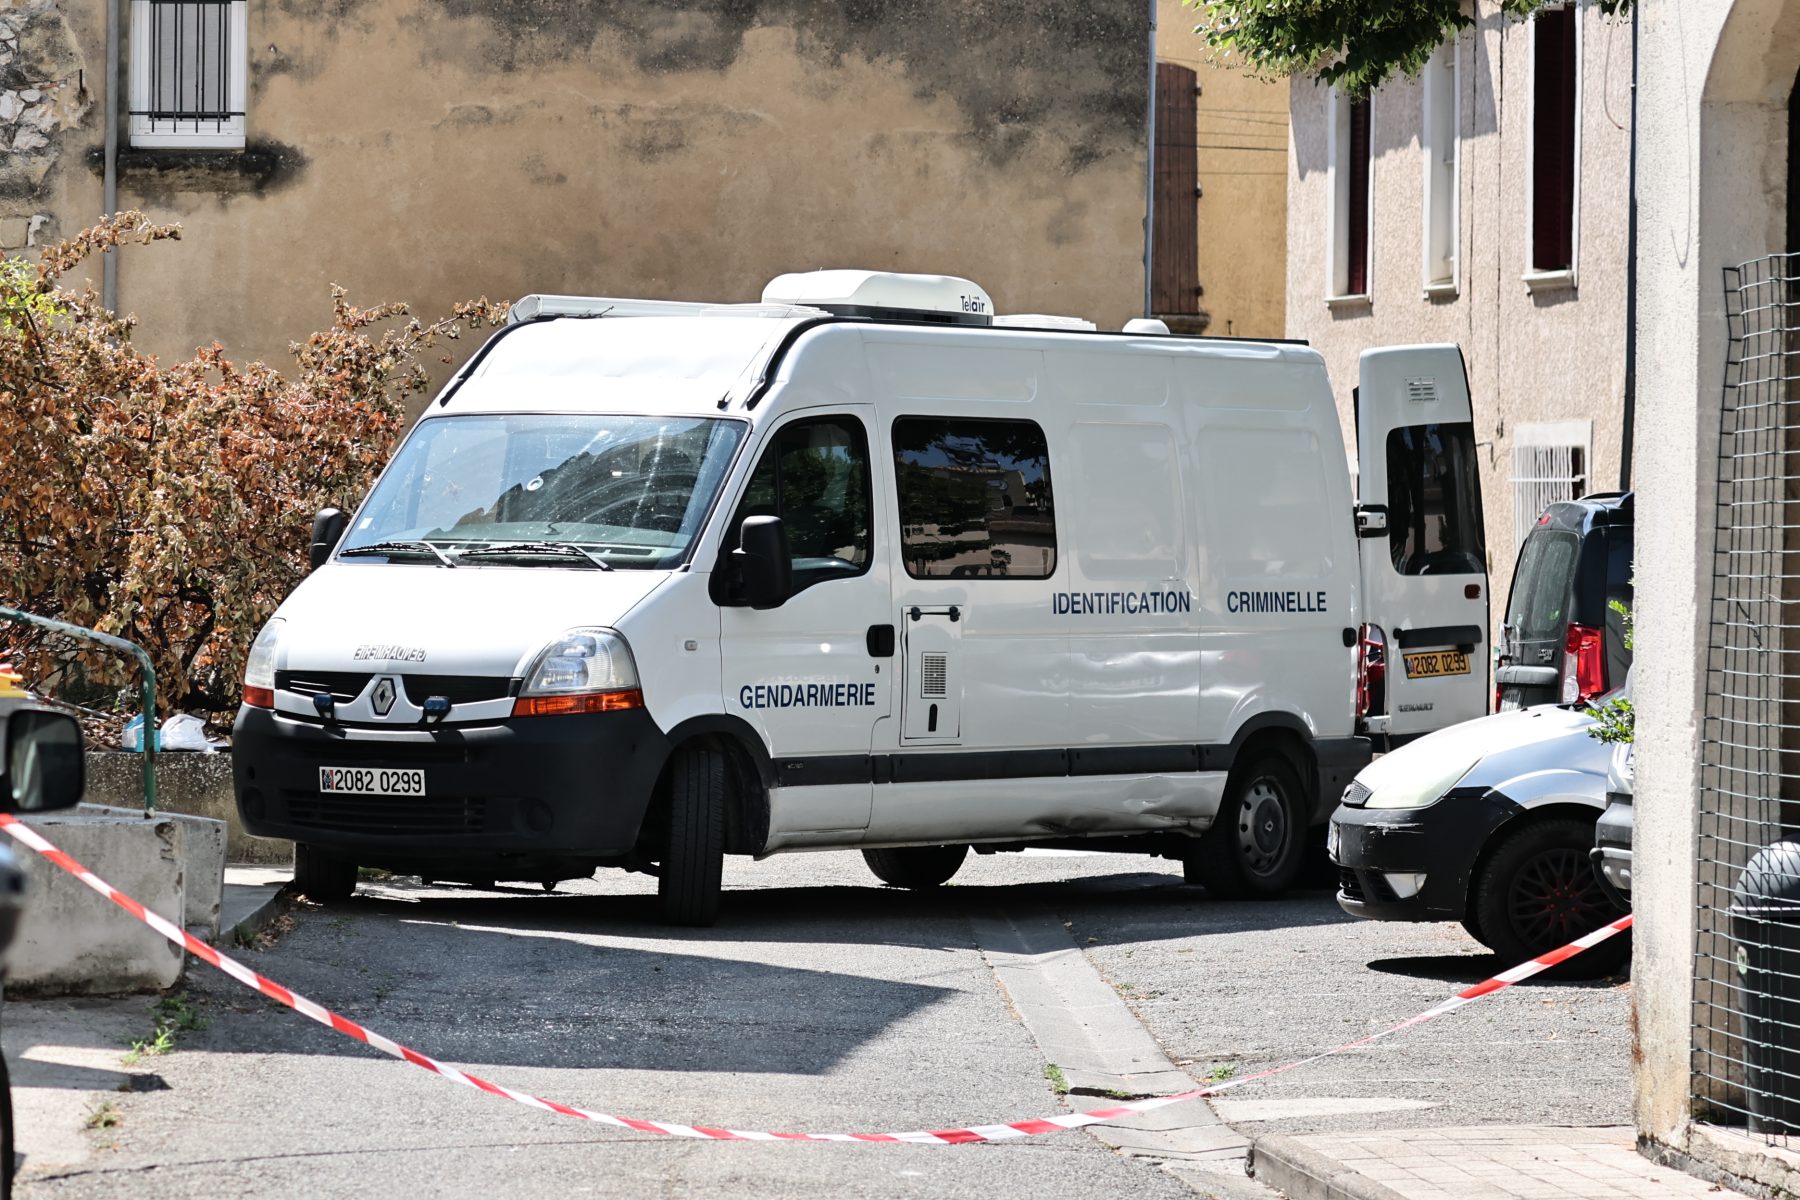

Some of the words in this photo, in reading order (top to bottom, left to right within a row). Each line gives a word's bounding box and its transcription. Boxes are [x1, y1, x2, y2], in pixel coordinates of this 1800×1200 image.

[960, 294, 985, 312] Telair
[1052, 591, 1191, 615] IDENTIFICATION
[1227, 591, 1327, 613] CRIMINELLE
[1413, 655, 1440, 674] 2082
[1441, 653, 1467, 673] 0299
[739, 683, 876, 709] GENDARMERIE
[334, 769, 375, 792] 2082
[380, 771, 422, 793] 0299
